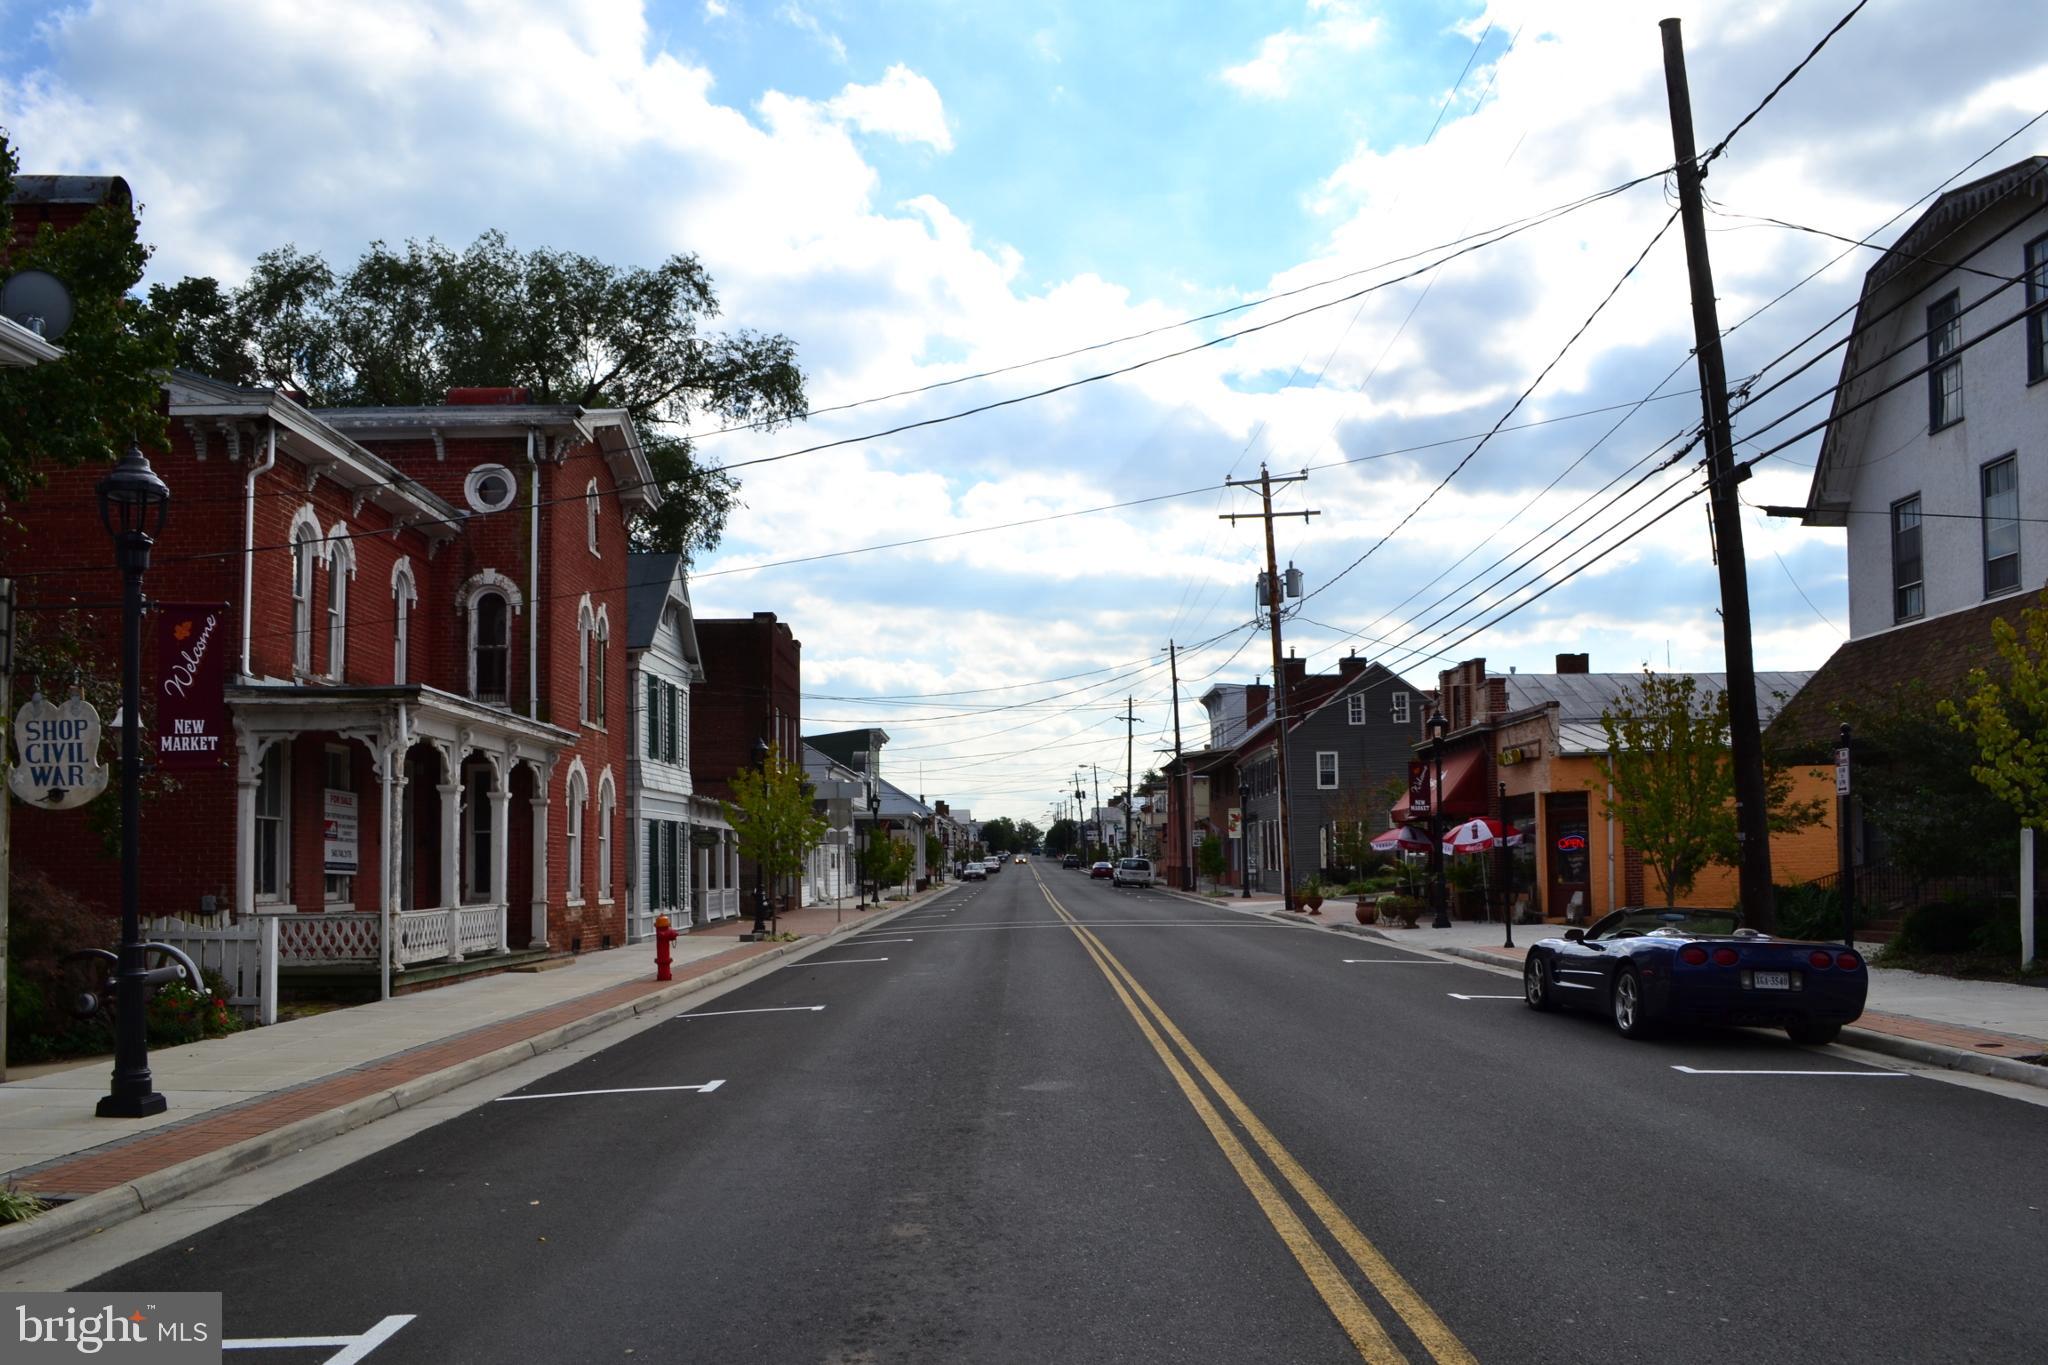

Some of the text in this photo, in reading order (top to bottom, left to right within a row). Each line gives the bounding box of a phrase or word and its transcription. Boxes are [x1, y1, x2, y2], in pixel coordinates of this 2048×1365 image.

[165, 614, 217, 698] Welcome
[25, 720, 88, 741] SHOP
[174, 719, 205, 734] NEW
[25, 743, 89, 764] CIVIL
[161, 735, 218, 752] MARKET
[30, 766, 84, 787] WAR
[1557, 837, 1585, 849] OPEN
